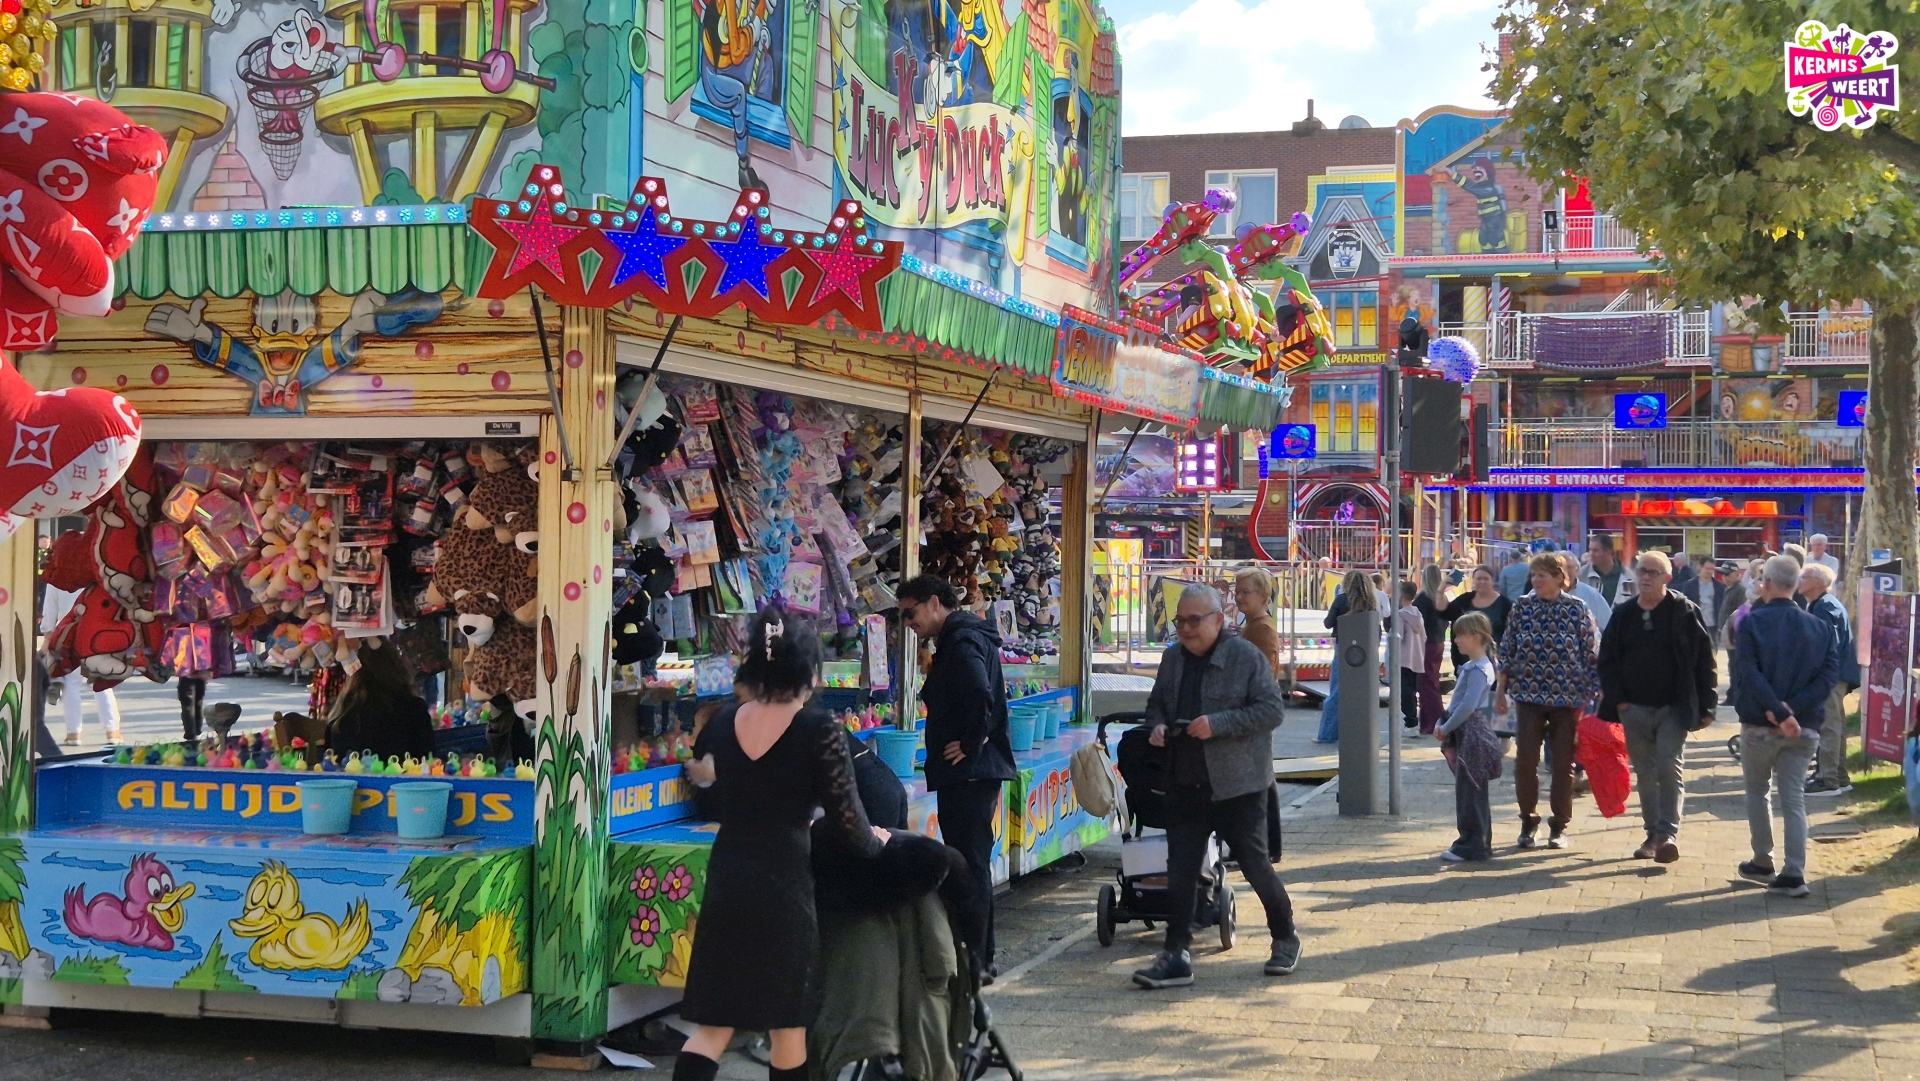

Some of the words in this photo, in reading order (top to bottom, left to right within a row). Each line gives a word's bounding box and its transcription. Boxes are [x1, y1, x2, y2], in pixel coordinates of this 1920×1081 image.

[1330, 353, 1387, 364] DEPARTMENT
[1474, 474, 1551, 485] FIGHTERS
[1555, 474, 1625, 485] ENTRANCE
[1880, 576, 1894, 591] P
[117, 780, 302, 819] ALTIJD
[352, 788, 514, 827] PJS
[611, 782, 653, 818] KLEINE
